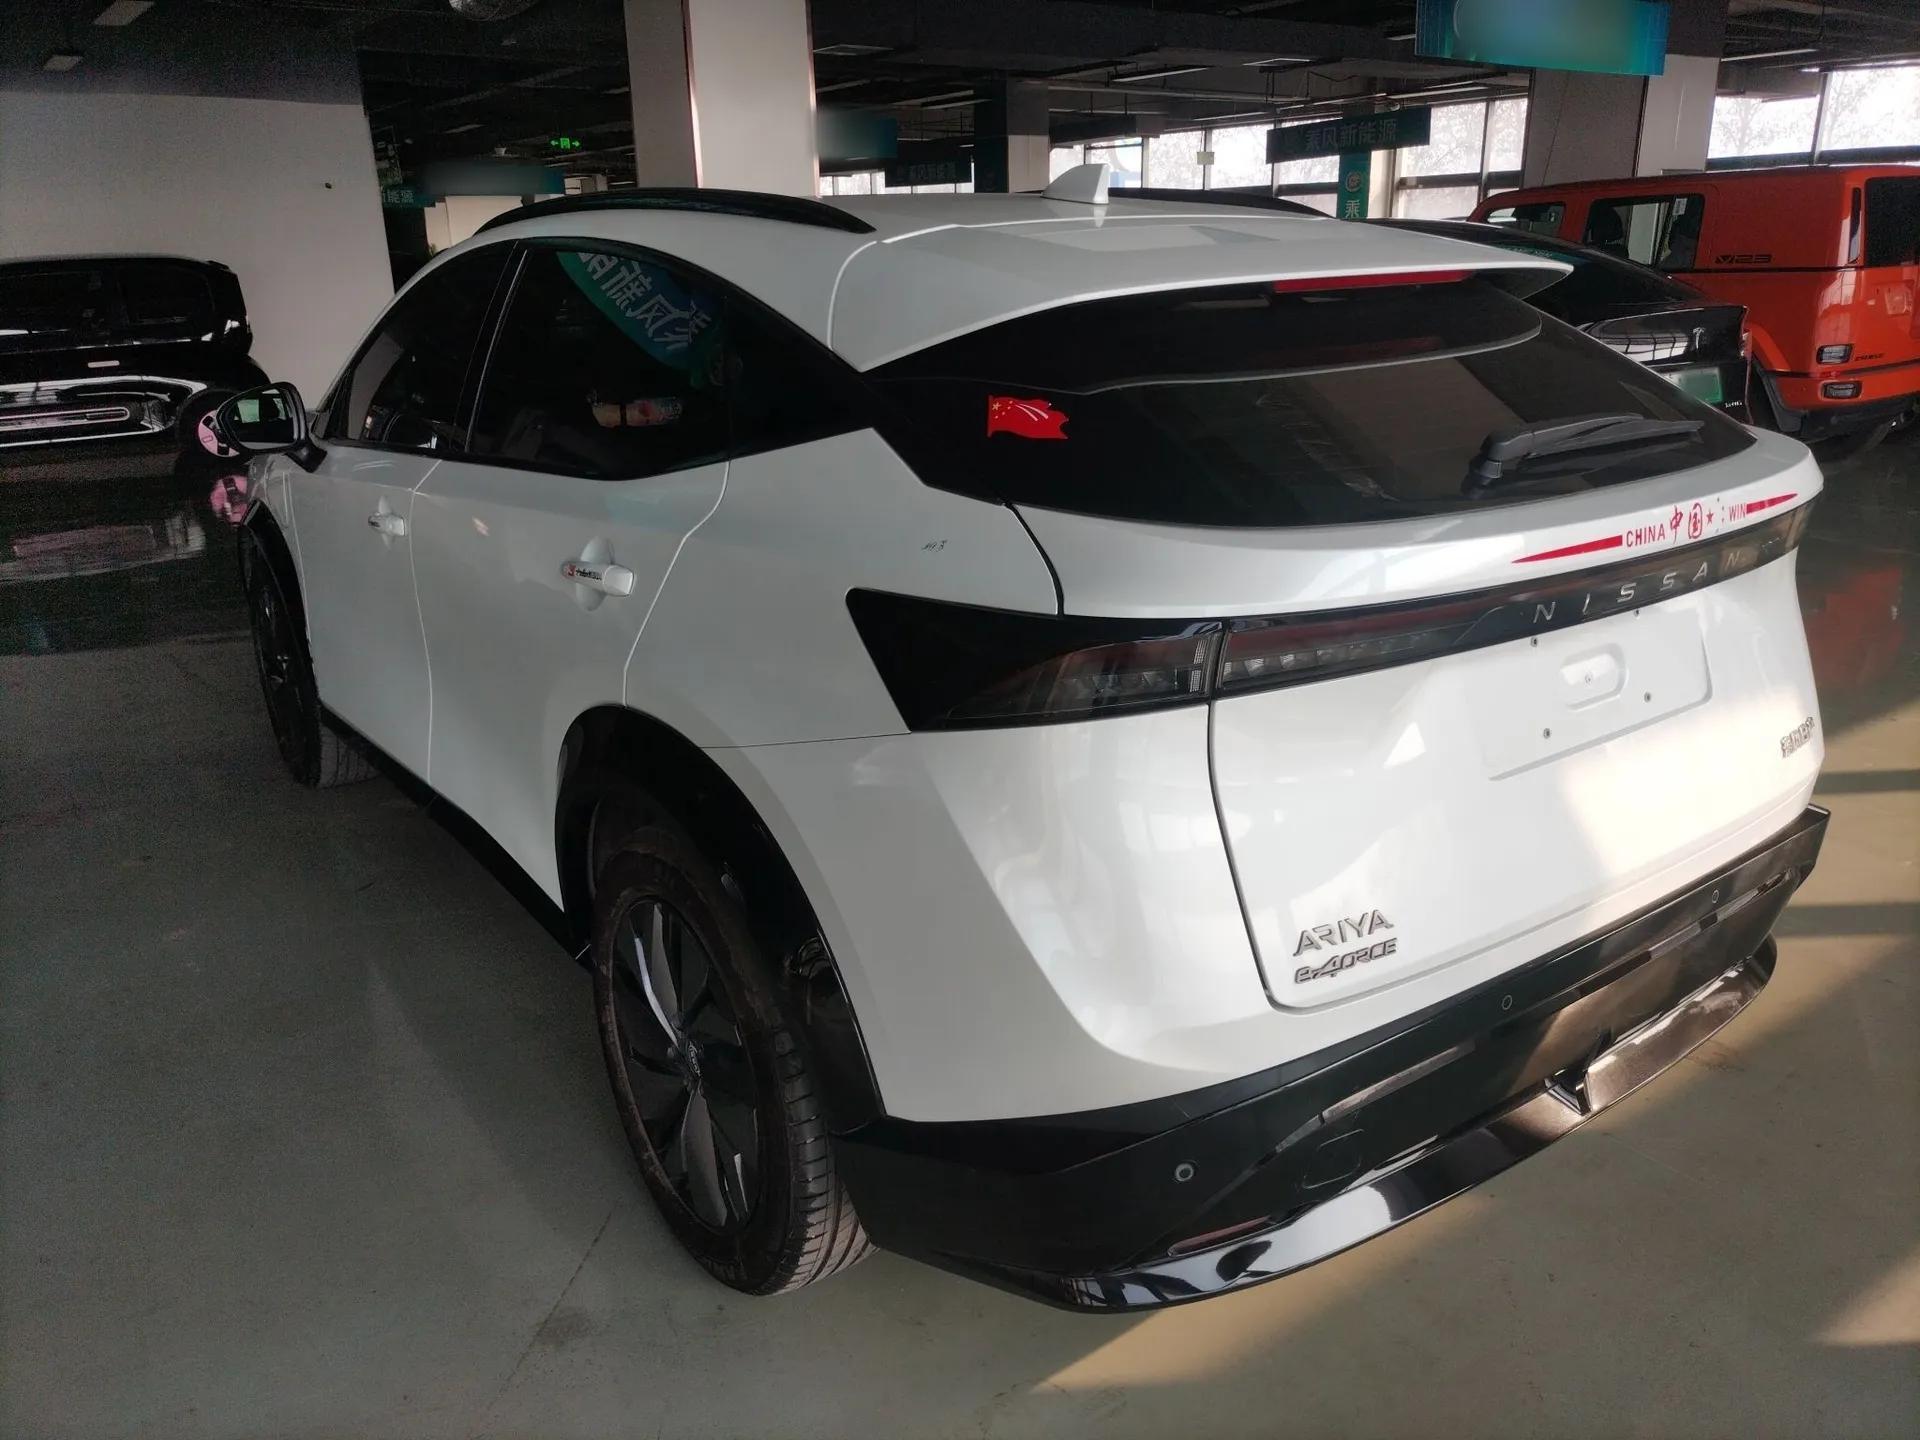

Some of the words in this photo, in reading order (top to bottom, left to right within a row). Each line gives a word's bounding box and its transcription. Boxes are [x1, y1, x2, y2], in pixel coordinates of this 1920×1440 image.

[1305, 118, 1398, 151] 乘风新能源
[383, 189, 415, 204] 能源
[1626, 523, 1666, 547] CHINA
[1728, 502, 1747, 522] WIN
[1533, 552, 1740, 623] NISSAN
[1292, 909, 1395, 957] ARIYA
